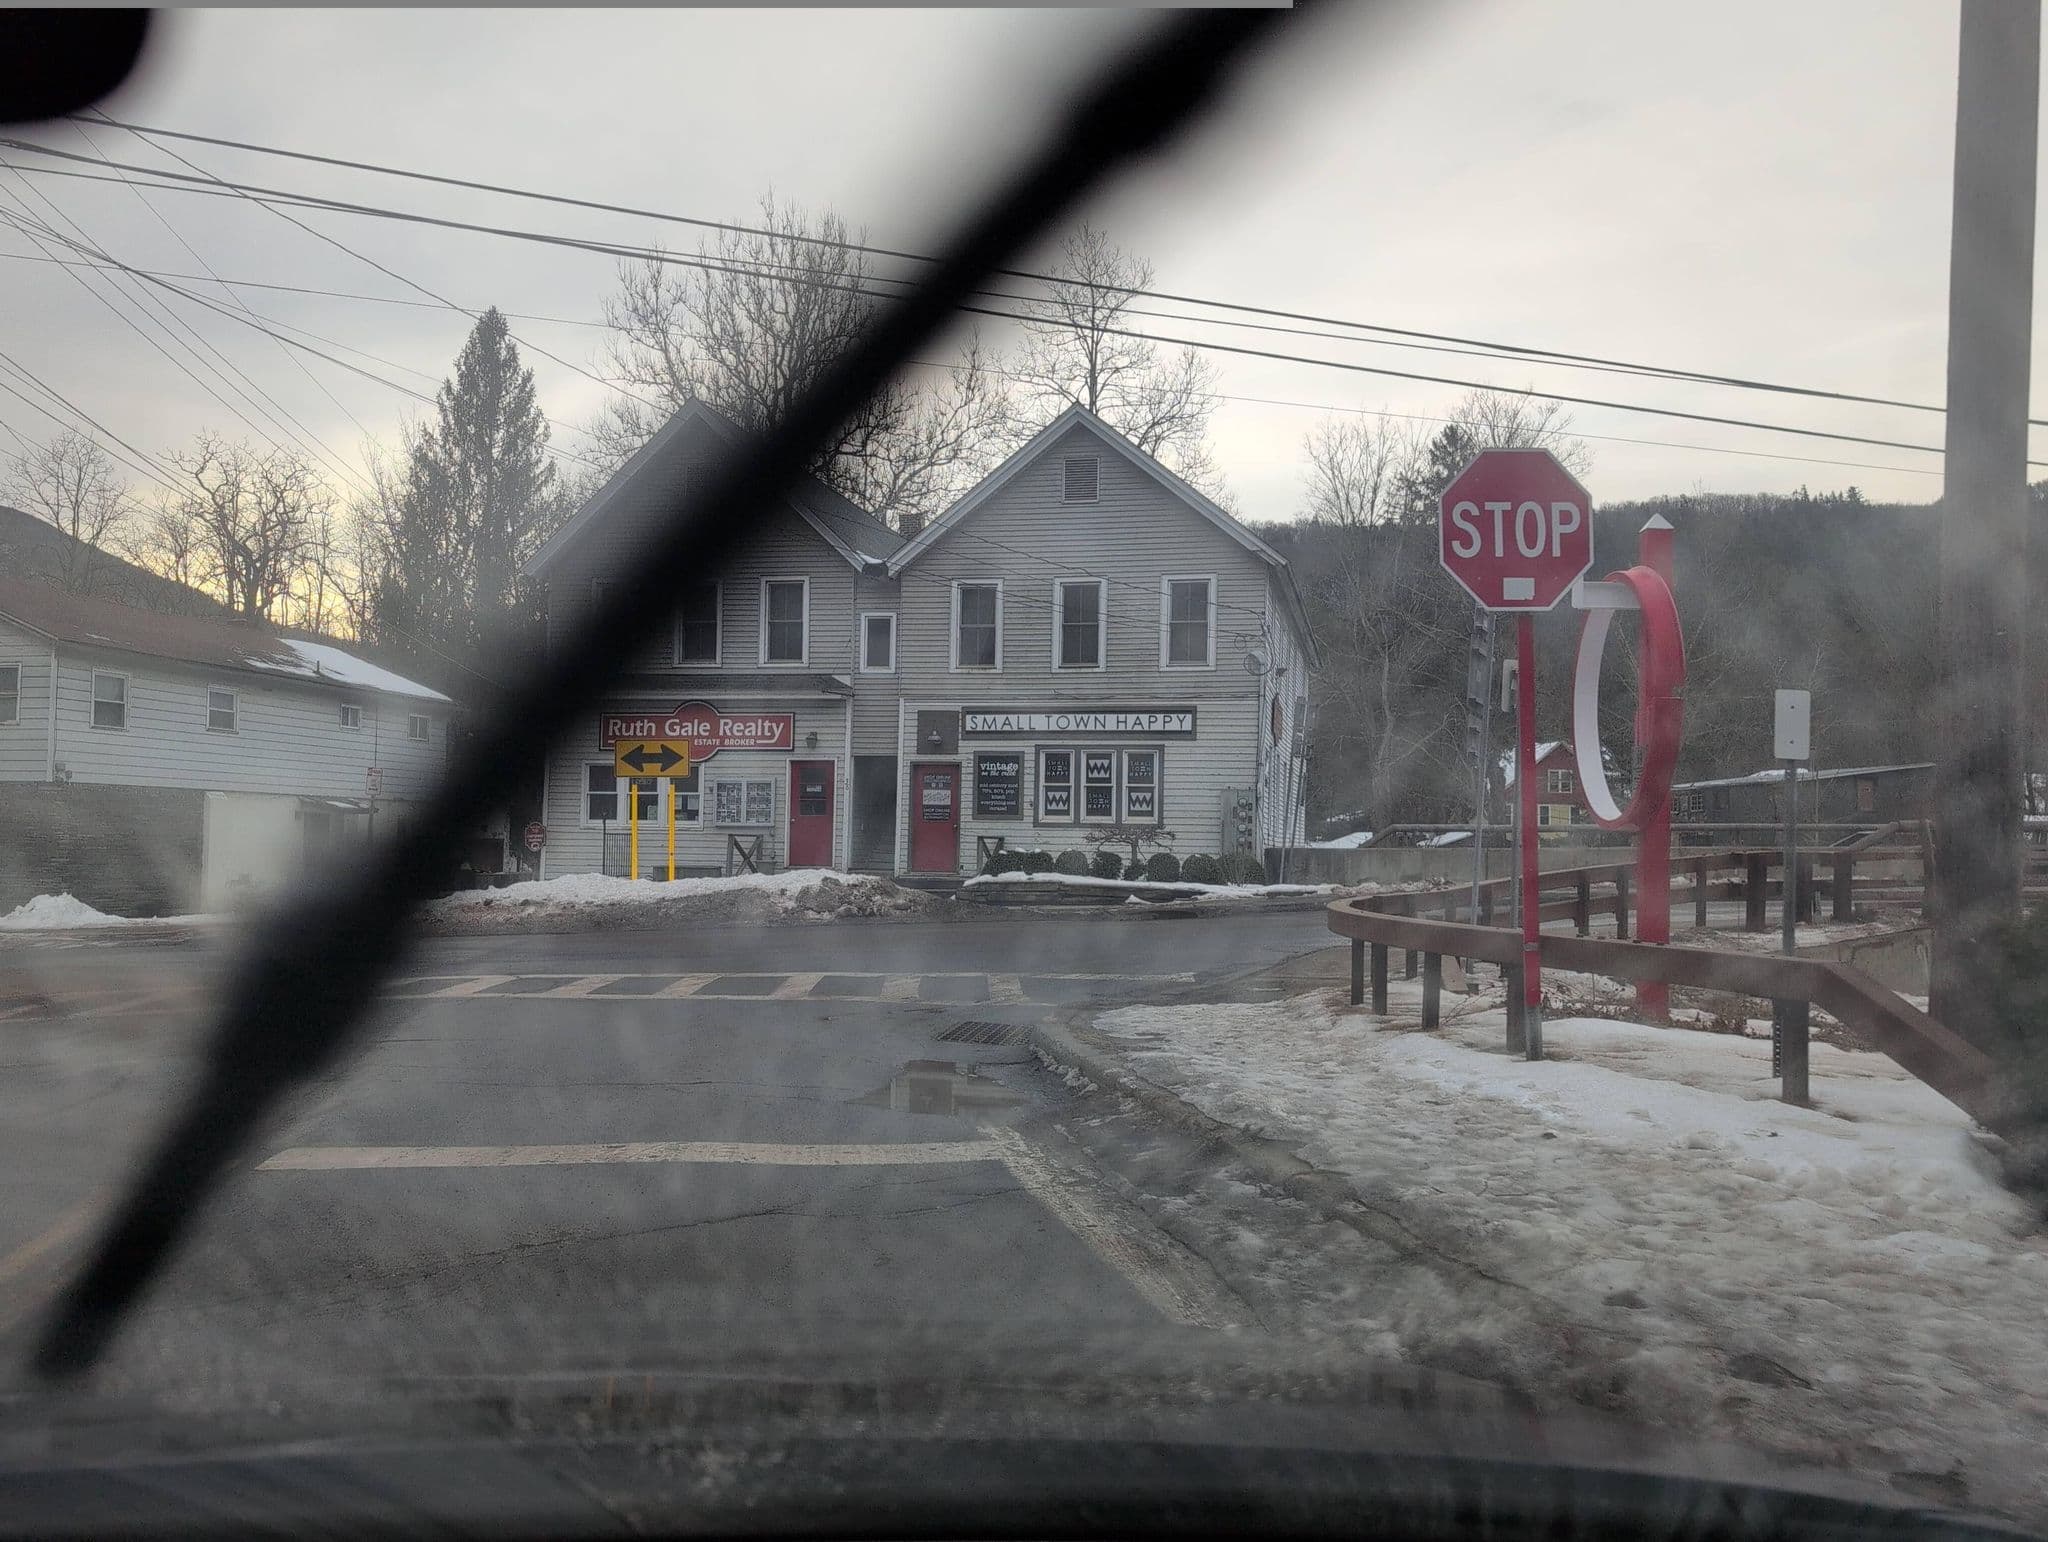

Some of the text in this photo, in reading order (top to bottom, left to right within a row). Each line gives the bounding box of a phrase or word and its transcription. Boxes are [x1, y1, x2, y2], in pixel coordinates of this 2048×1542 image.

[1452, 501, 1581, 558] STOP
[608, 718, 784, 741] Ruth Gale Realty
[969, 715, 1187, 730] SMALL TOWN HAPPY
[694, 738, 755, 746] ESTATE BROKER
[980, 762, 1019, 772] vintage
